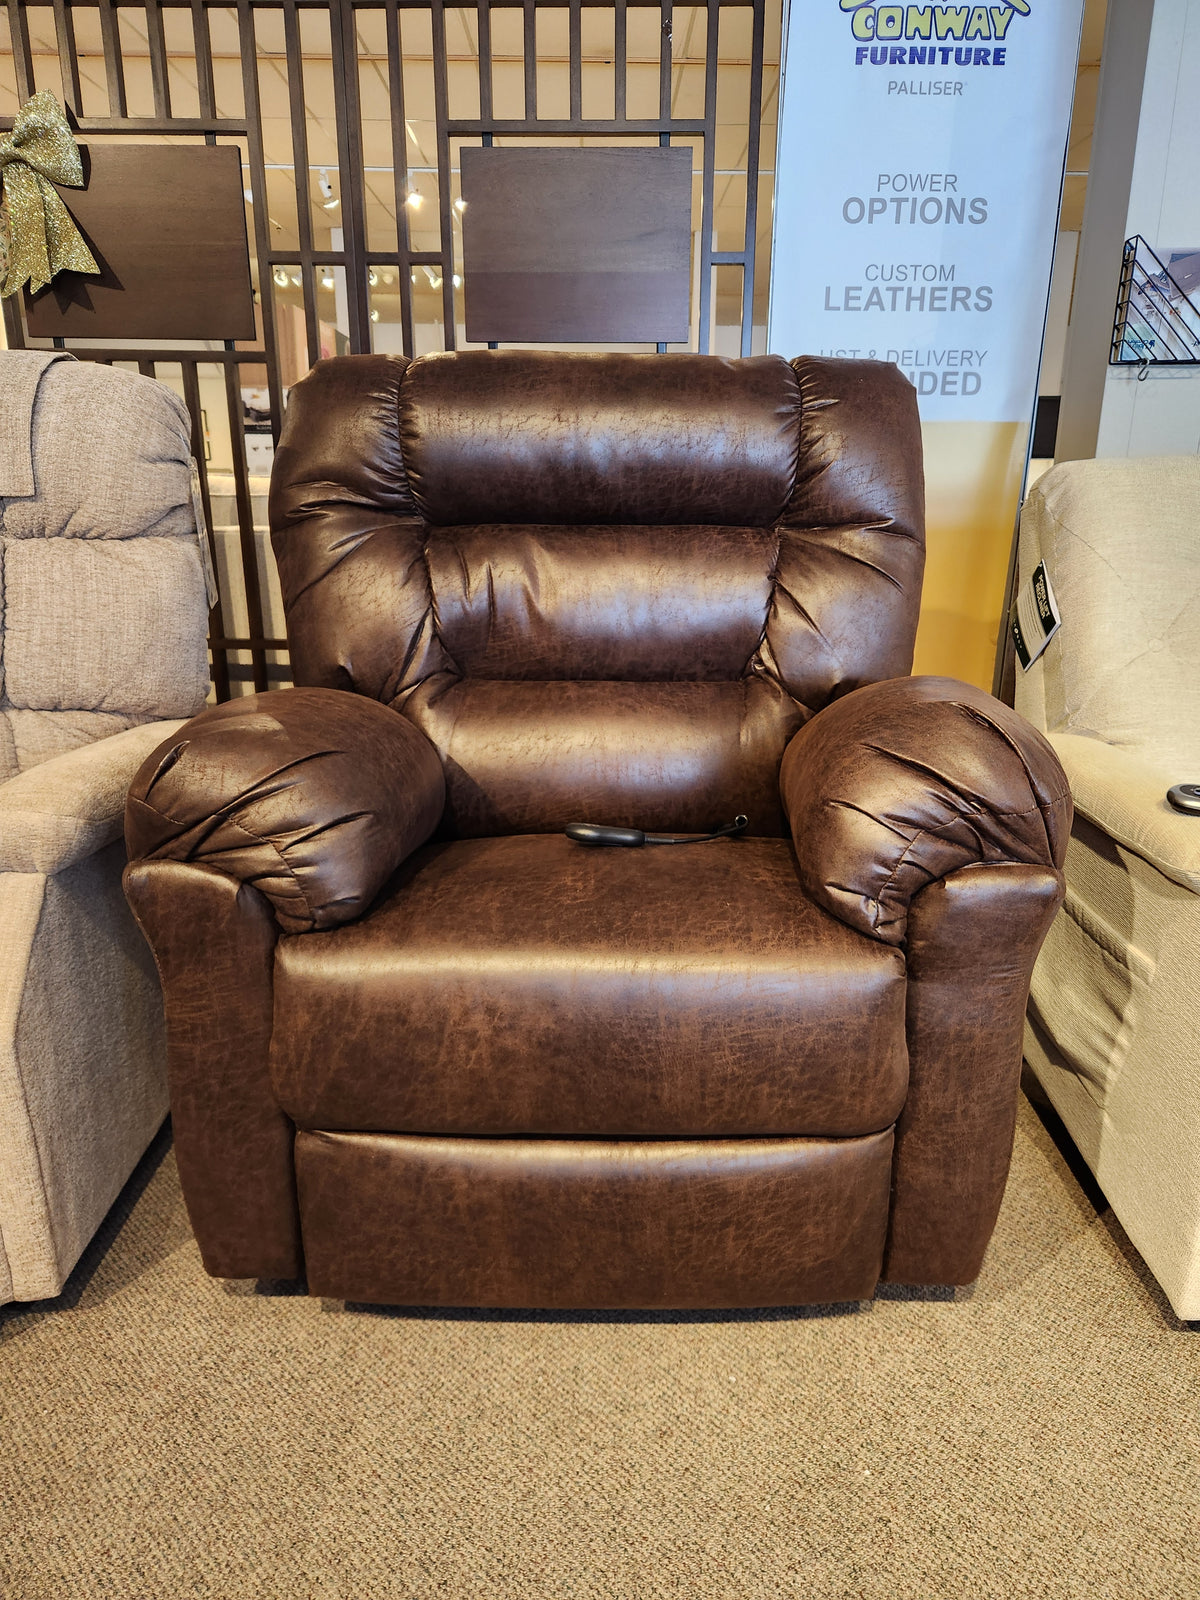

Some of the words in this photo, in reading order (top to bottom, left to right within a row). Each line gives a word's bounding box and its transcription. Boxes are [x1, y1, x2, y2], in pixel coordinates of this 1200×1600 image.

[851, 5, 1015, 41] CONWAY
[855, 47, 1006, 66] FURNITURE
[888, 81, 963, 96] PALLISER
[877, 174, 958, 193] POWER
[842, 197, 988, 225] OPTIONS
[865, 264, 955, 282] CUSTOM
[824, 286, 993, 312] LEATHERS
[887, 350, 988, 366] DELIVERY
